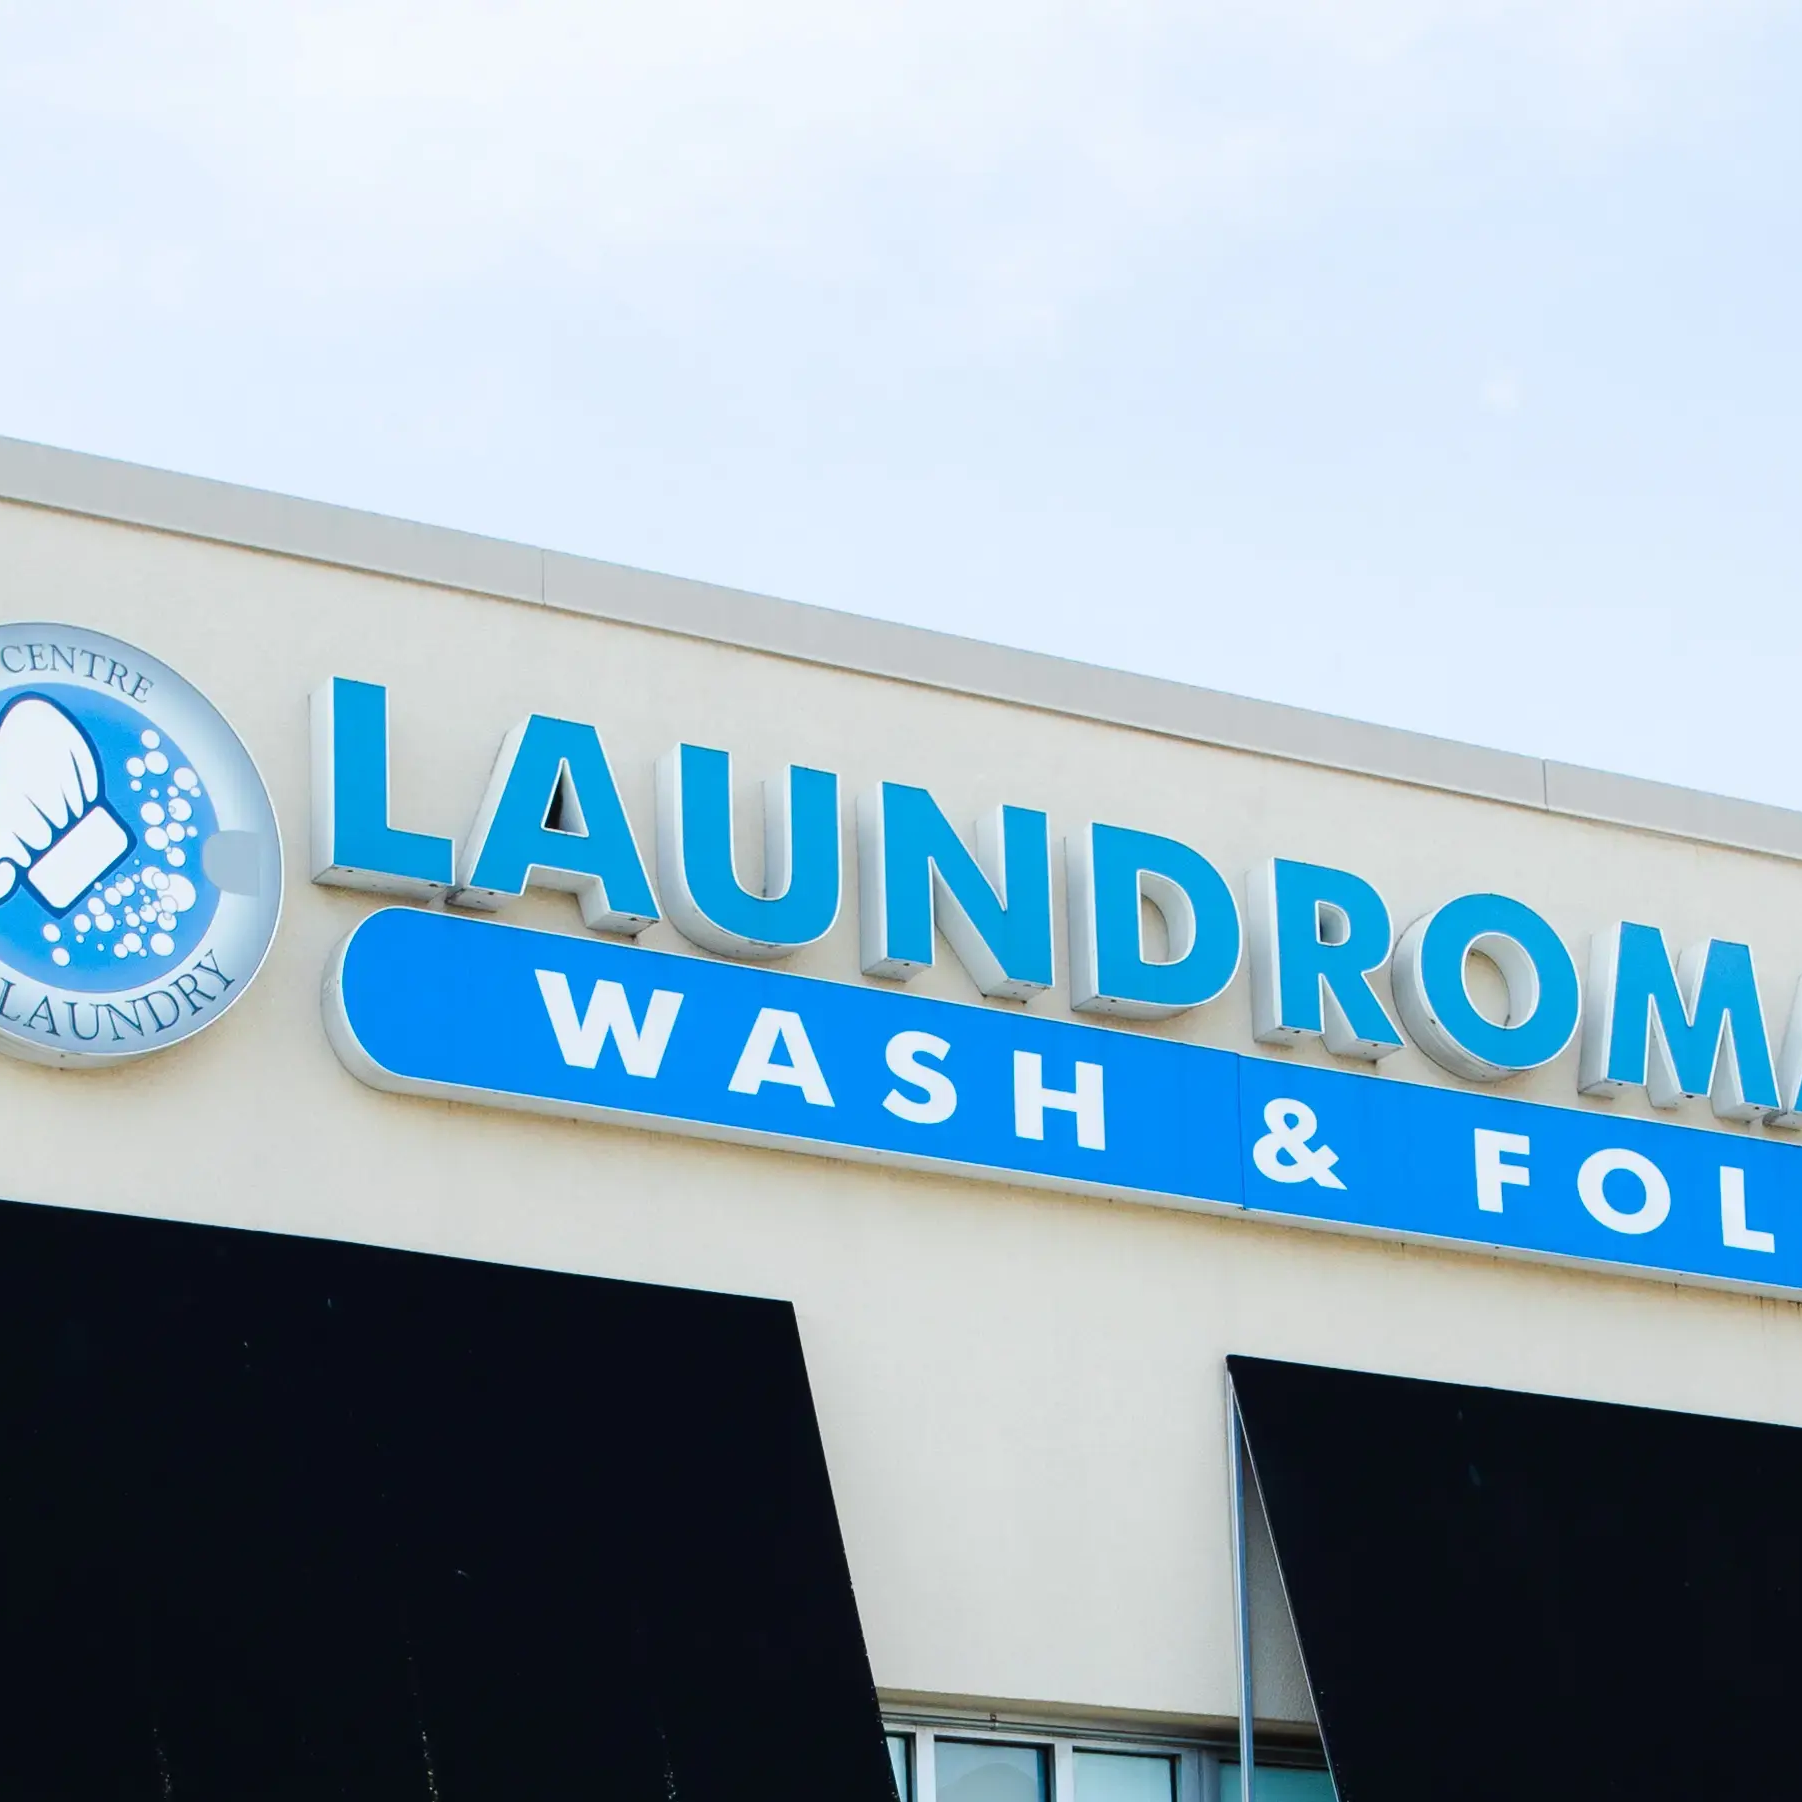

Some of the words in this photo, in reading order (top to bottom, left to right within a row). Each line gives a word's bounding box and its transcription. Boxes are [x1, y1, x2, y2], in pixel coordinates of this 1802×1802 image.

[0, 643, 155, 704] CENTRE
[535, 970, 1107, 1151] WASH
[1252, 1097, 1349, 1190] &
